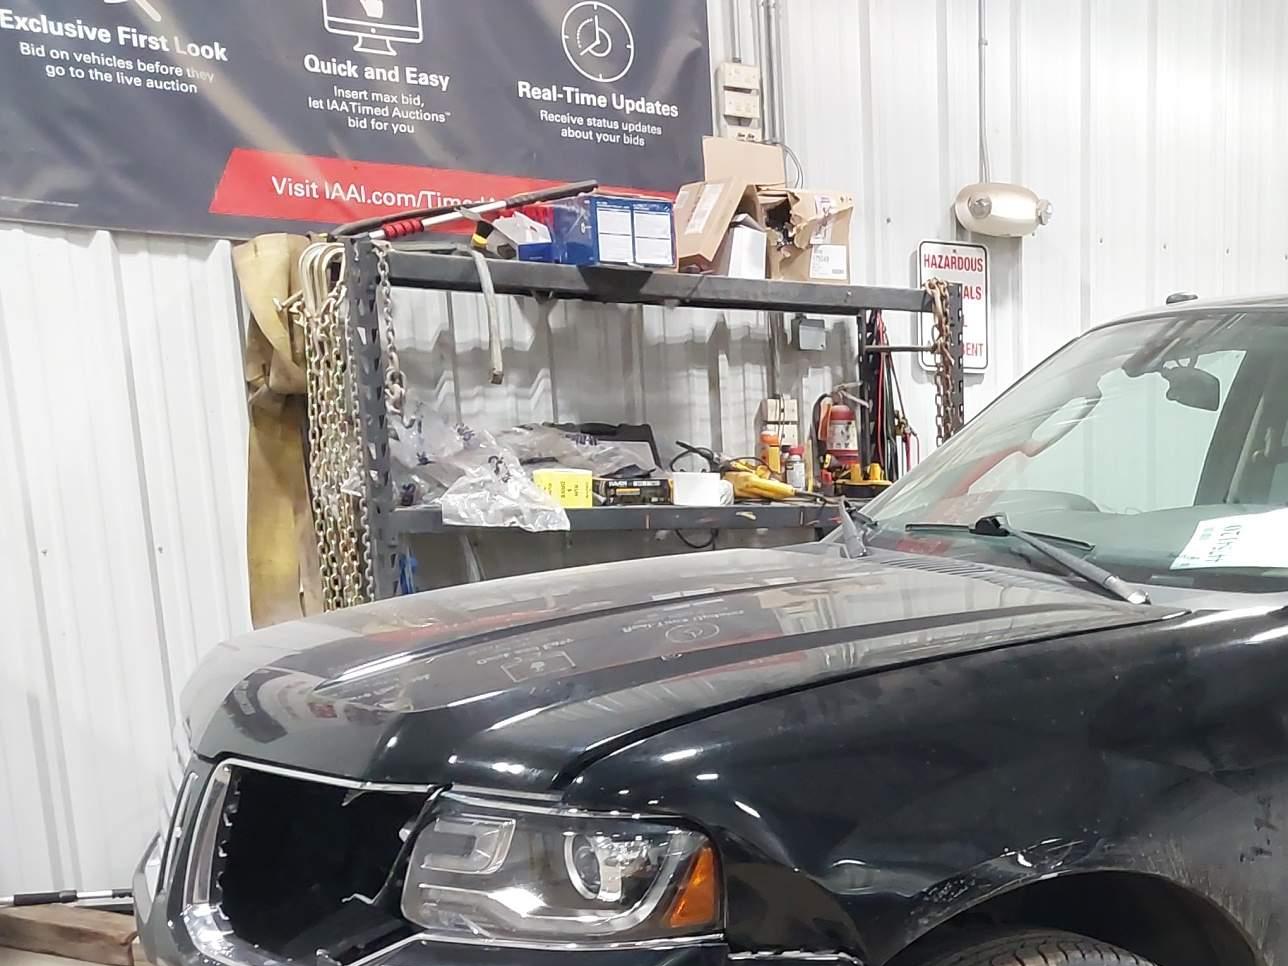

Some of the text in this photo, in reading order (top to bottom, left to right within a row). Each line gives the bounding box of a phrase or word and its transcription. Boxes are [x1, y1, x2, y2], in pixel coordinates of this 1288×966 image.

[0, 8, 228, 62] Exclusive First Look
[19, 42, 214, 83] Bid on vehicles before they
[304, 54, 450, 91] Quick and Easy
[45, 64, 198, 94] go to the live auction
[308, 97, 323, 109] let
[334, 85, 424, 107] Insert max bid,
[517, 81, 679, 117] Real-Time Updates
[348, 117, 414, 134] bid for you
[540, 110, 662, 135] Receive status updates
[561, 127, 644, 146] about your bids
[272, 176, 319, 198] Visit
[923, 254, 983, 273] HAZARDOUS
